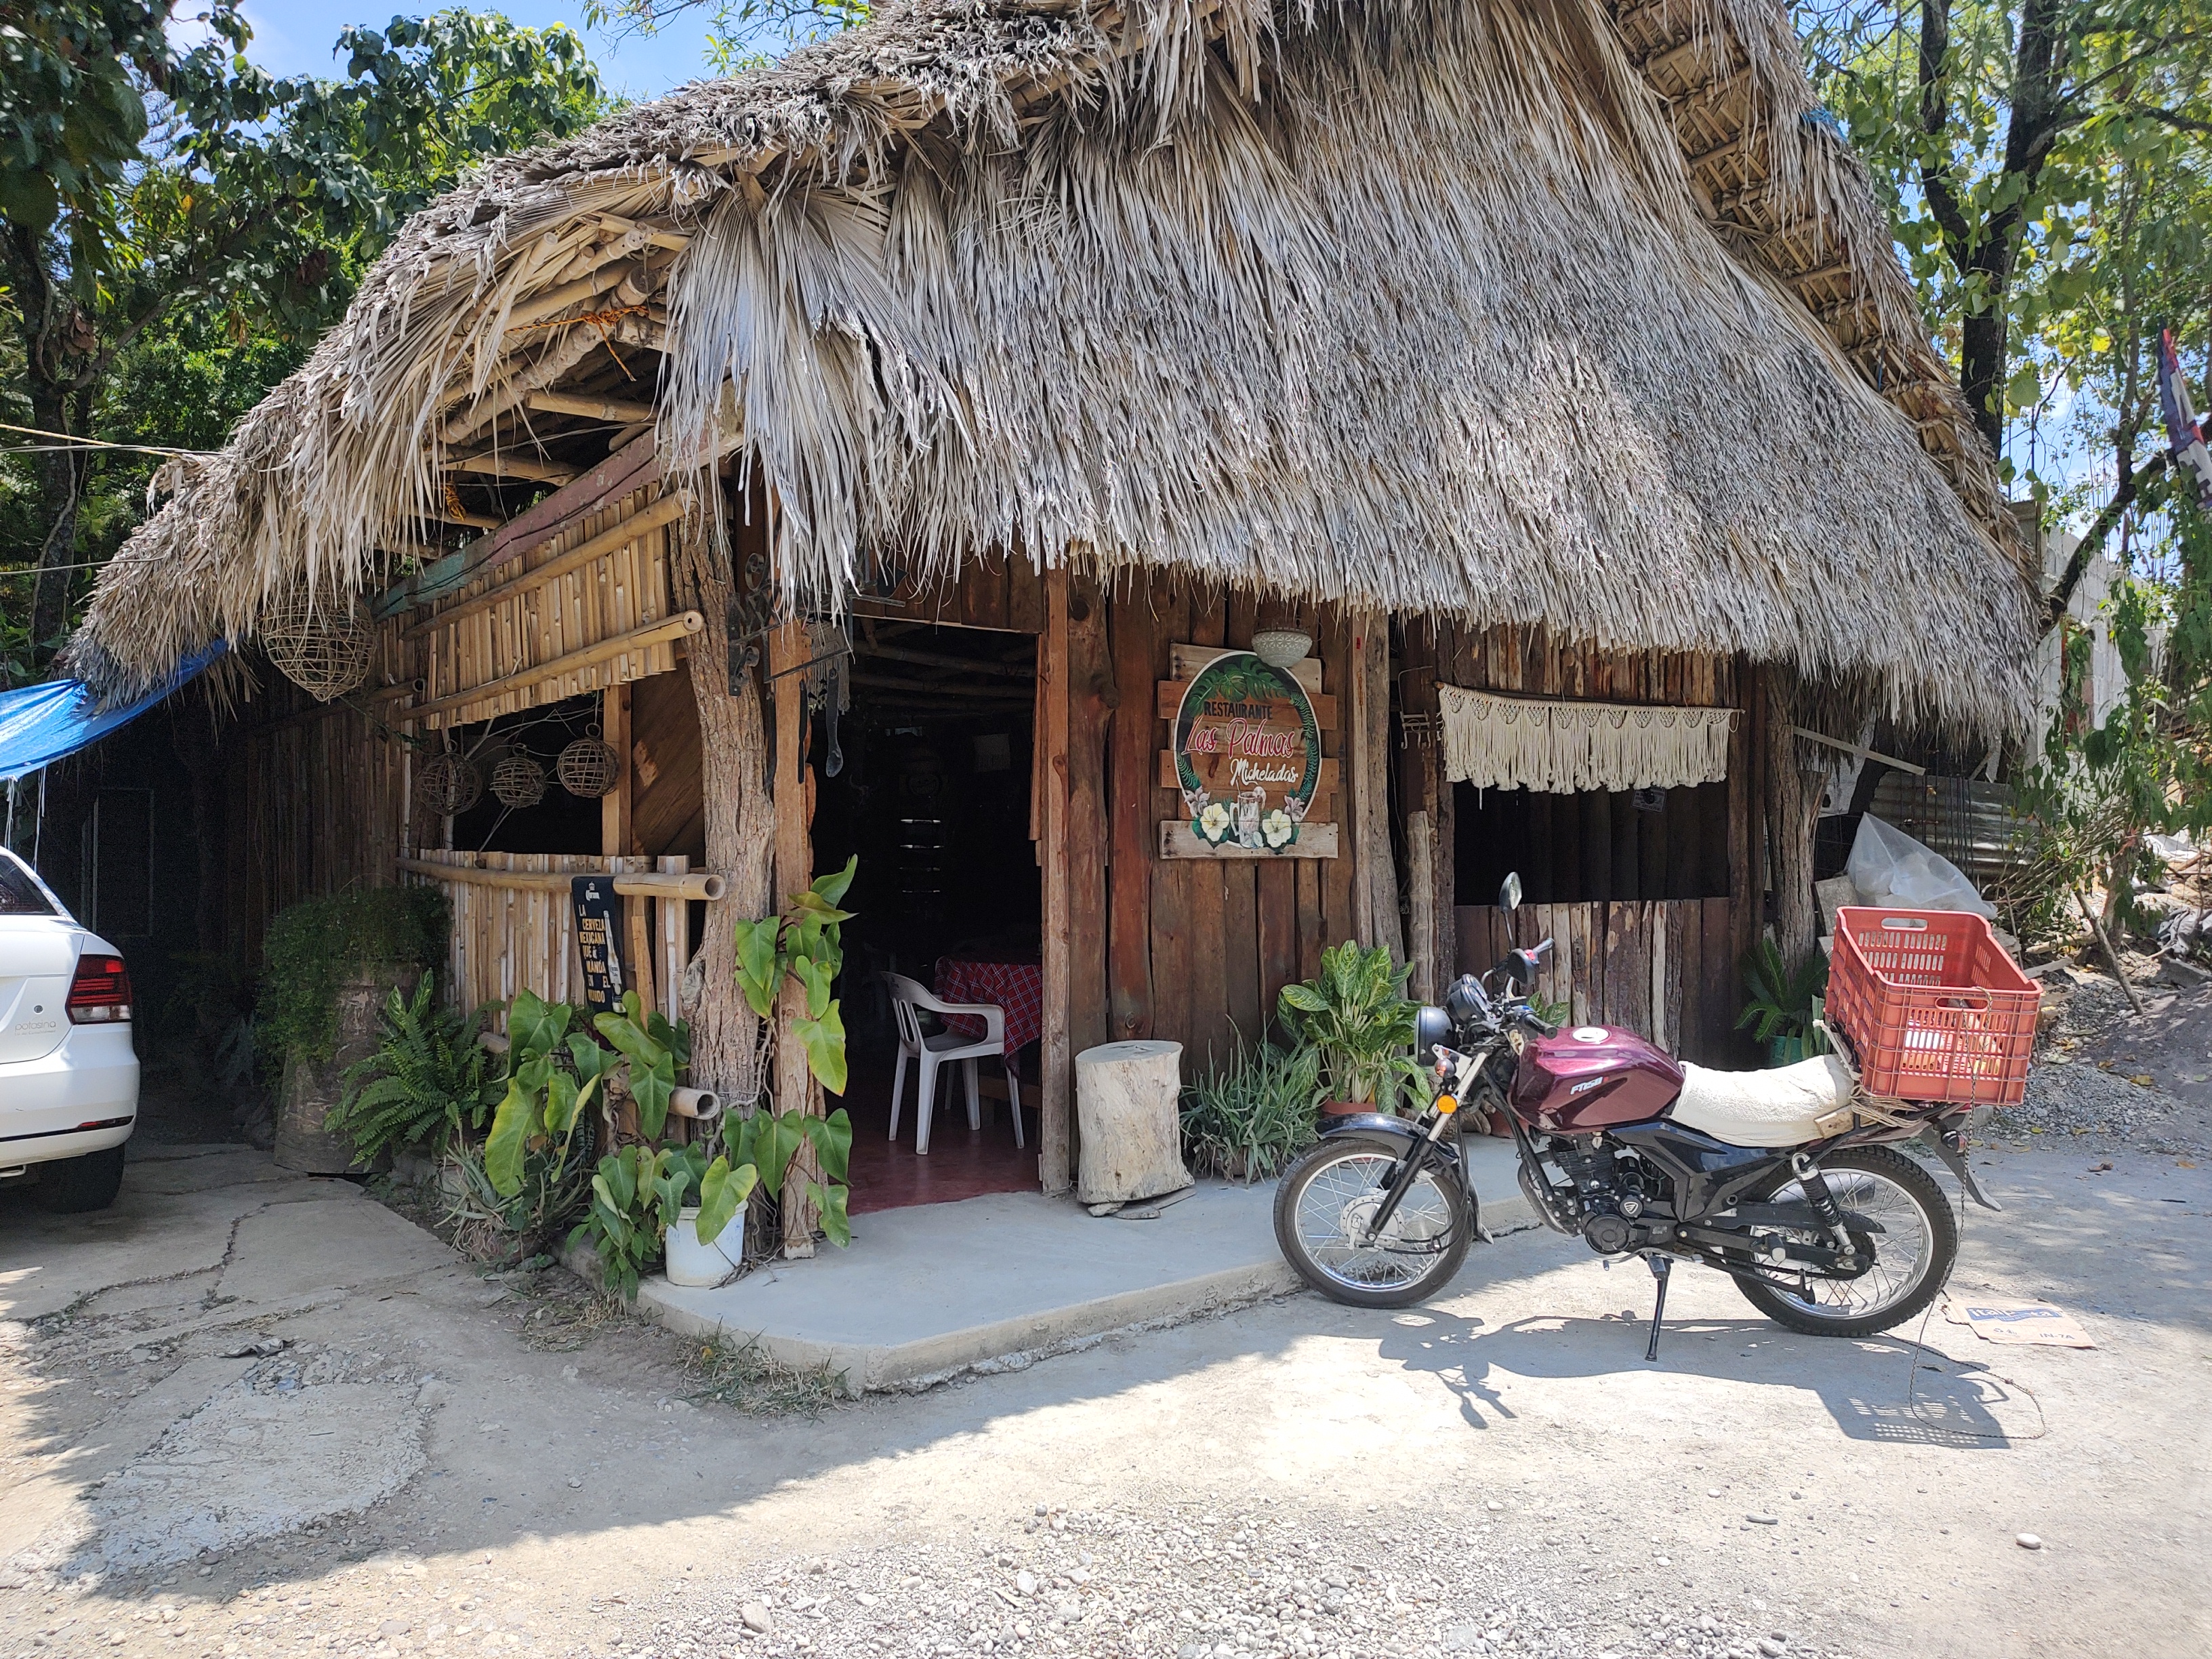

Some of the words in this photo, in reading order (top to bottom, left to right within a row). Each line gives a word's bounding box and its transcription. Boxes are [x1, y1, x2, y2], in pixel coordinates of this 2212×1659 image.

[1204, 701, 1273, 719] RESTAURANTE
[1181, 715, 1217, 756] Las
[1226, 717, 1295, 759] Palmas
[1230, 758, 1299, 786] Micheladas
[579, 905, 586, 916] LA
[582, 918, 605, 930] CERVEZA
[579, 932, 605, 944] MEXICANA
[586, 960, 606, 973] MANDA
[602, 975, 611, 988] EL
[588, 989, 605, 1003] MUNDO
[15, 1021, 56, 1031] potosina
